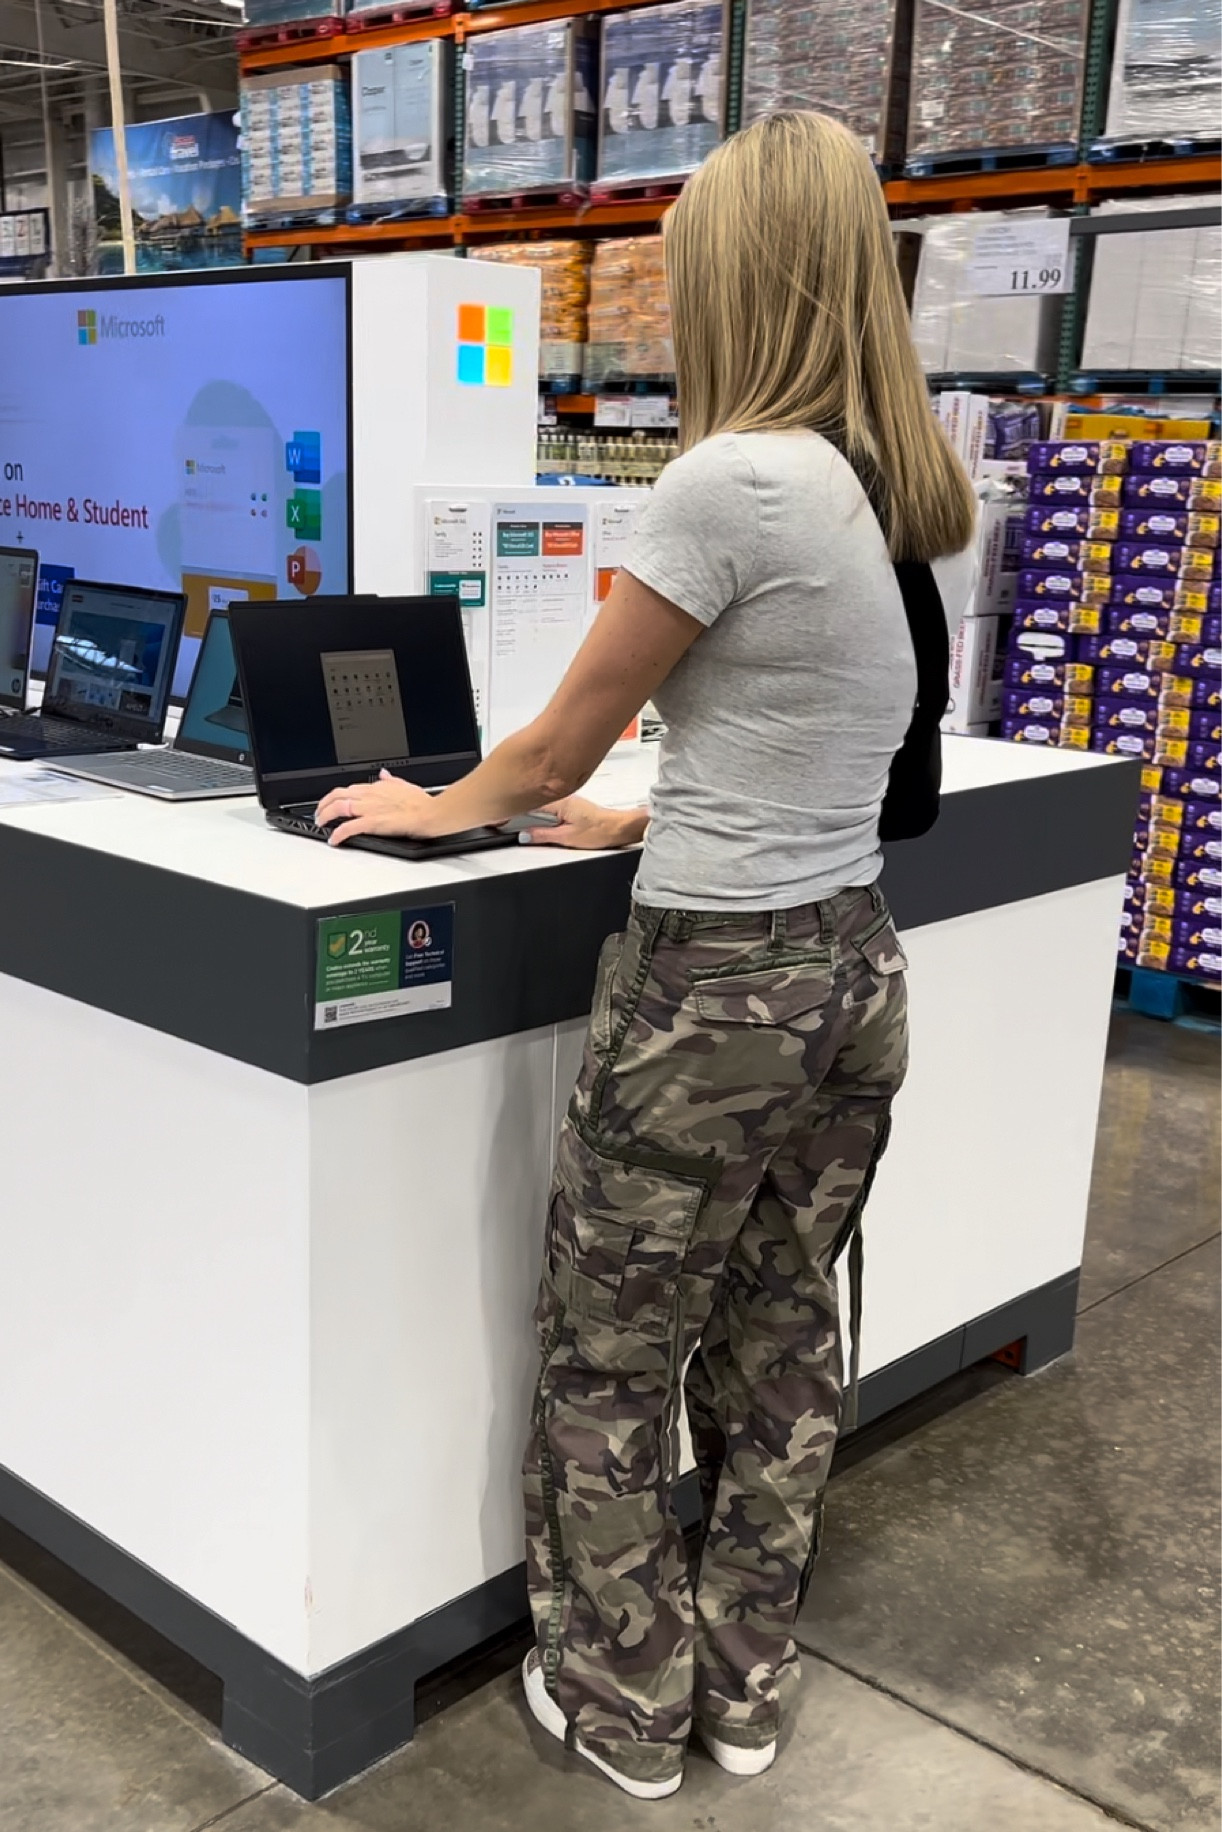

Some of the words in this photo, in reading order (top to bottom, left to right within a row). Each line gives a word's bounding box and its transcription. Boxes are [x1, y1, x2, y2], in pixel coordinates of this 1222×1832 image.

[1011, 267, 1062, 290] 11.99
[100, 314, 165, 339] Microsoft
[288, 448, 302, 466] W
[4, 461, 24, 482] on
[15, 493, 63, 522] Home
[66, 496, 80, 523] &
[83, 498, 149, 530] Student
[290, 505, 301, 524] X
[291, 560, 301, 578] P
[364, 944, 391, 954] warranty
